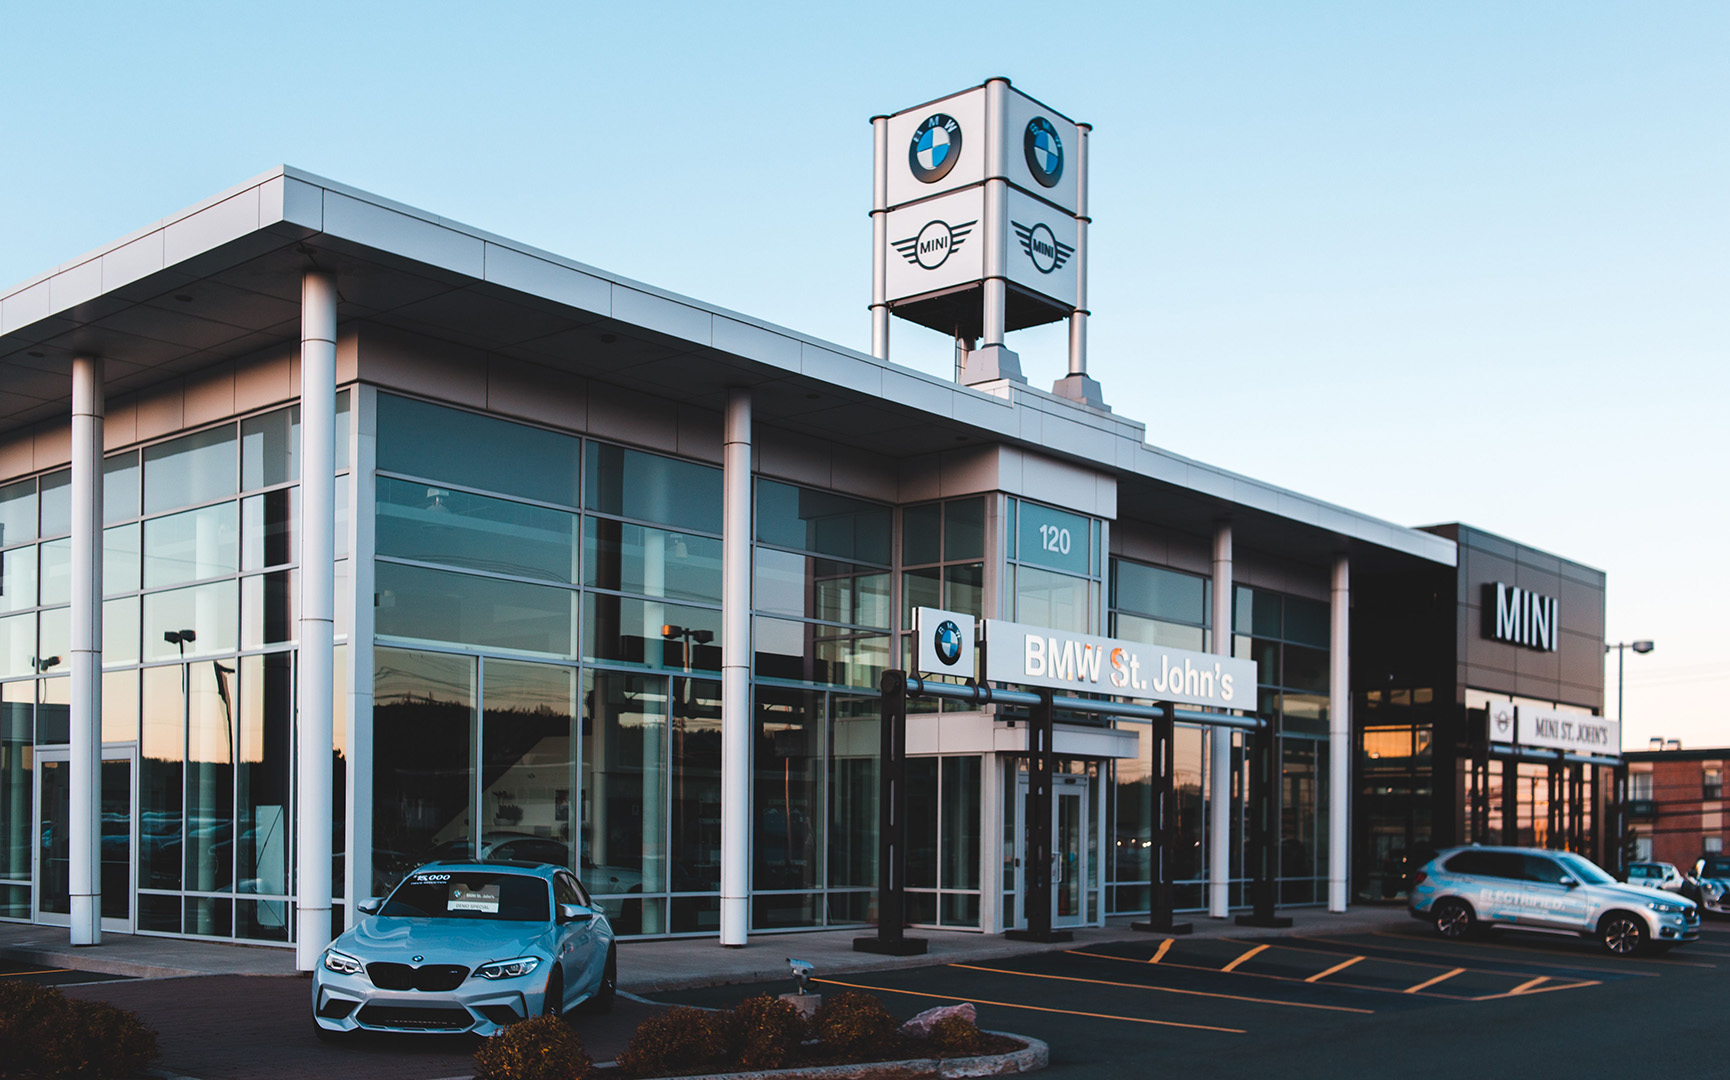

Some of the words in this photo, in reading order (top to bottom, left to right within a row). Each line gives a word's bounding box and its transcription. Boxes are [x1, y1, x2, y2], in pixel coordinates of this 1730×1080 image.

[913, 116, 957, 143] BMW
[920, 236, 948, 255] MINI
[1033, 238, 1054, 259] MINI
[1039, 523, 1071, 555] 120
[1496, 581, 1558, 652] MINI
[938, 622, 961, 639] BMW
[1024, 634, 1102, 683] BMW
[1109, 647, 1147, 690] St.
[1153, 654, 1234, 701] John's
[1535, 717, 1559, 740] MINI
[1561, 721, 1574, 741] ST.
[1577, 722, 1608, 745] JOHN'S
